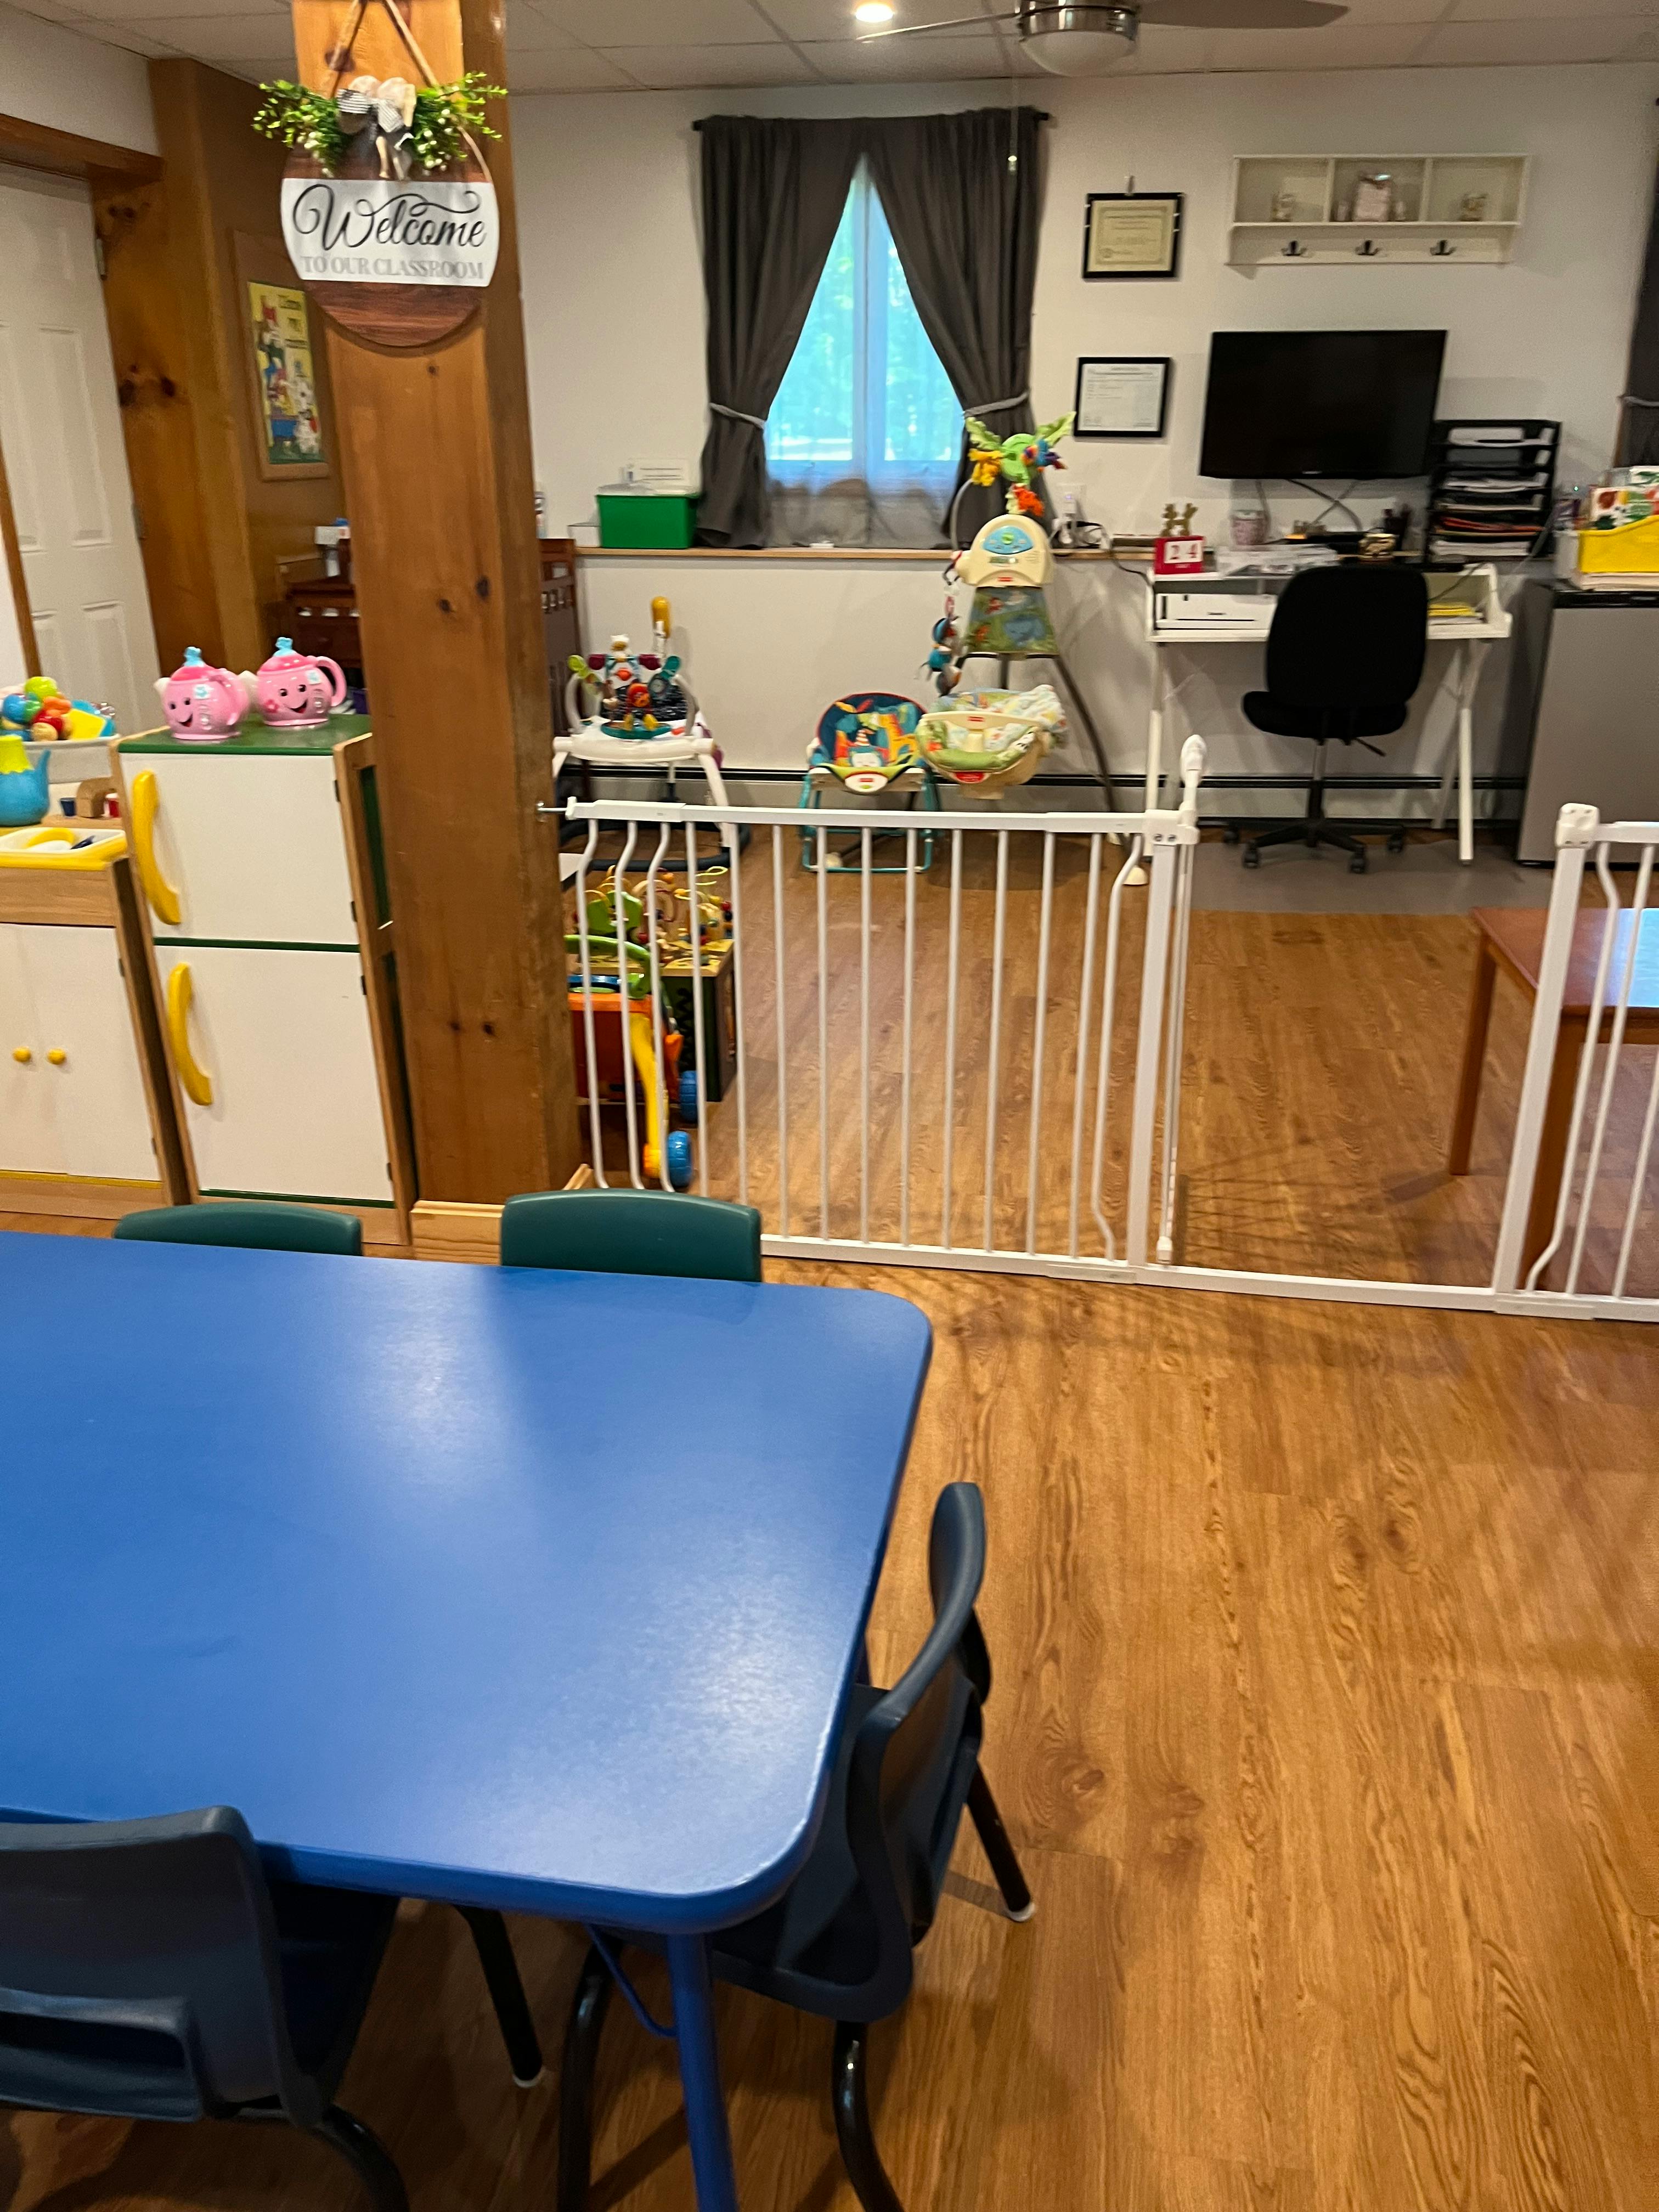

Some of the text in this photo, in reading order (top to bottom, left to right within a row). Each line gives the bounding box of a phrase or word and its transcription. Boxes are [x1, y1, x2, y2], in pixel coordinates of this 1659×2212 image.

[293, 184, 485, 251] Welcome
[301, 256, 484, 279] TO OUR CLASSROOM
